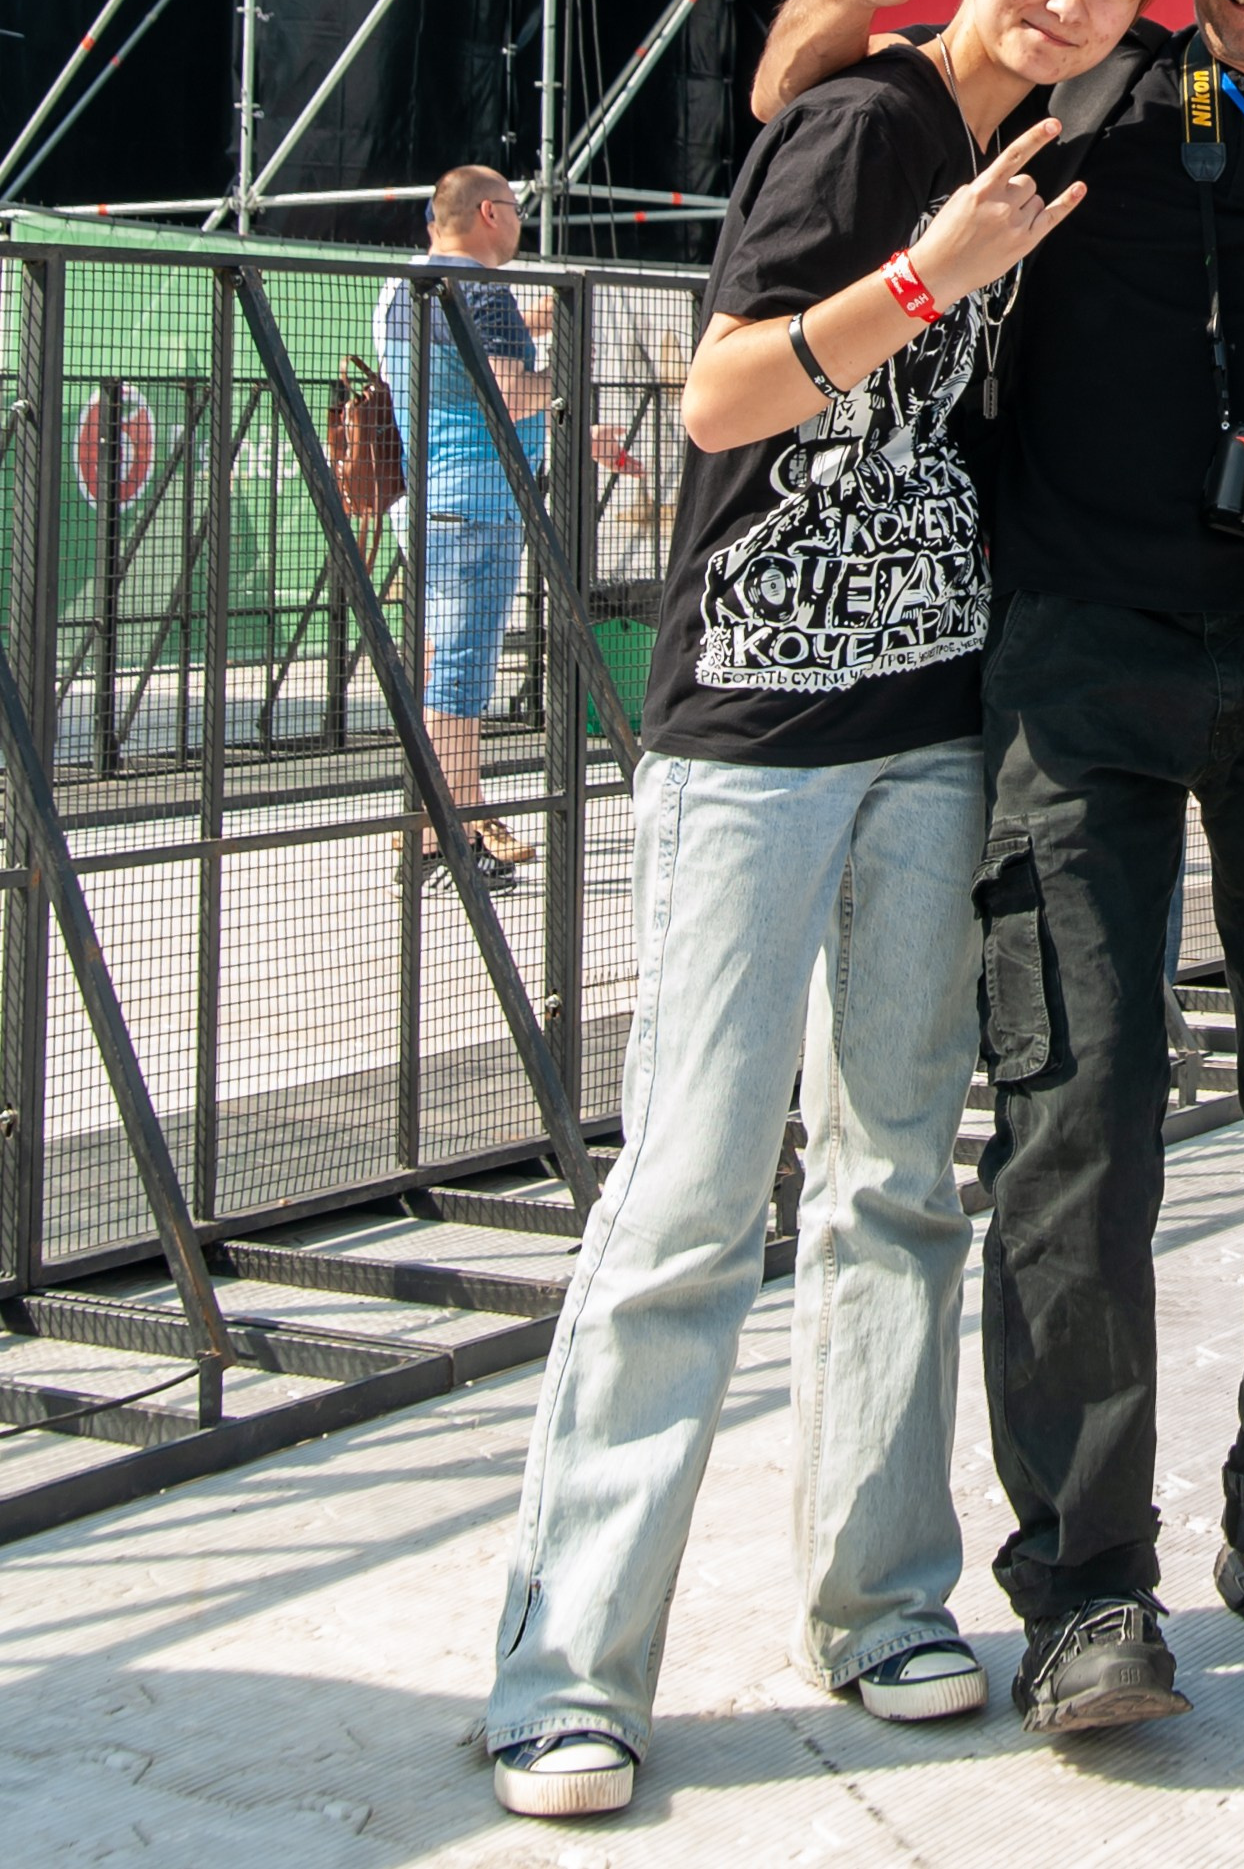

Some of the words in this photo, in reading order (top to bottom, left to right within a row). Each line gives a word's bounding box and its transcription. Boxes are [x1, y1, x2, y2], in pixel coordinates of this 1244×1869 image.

[1191, 69, 1213, 127] Nikon
[906, 292, 930, 311] ФАН
[700, 669, 787, 685] РАБОТАТЬ
[791, 671, 845, 687] СУТКИ
